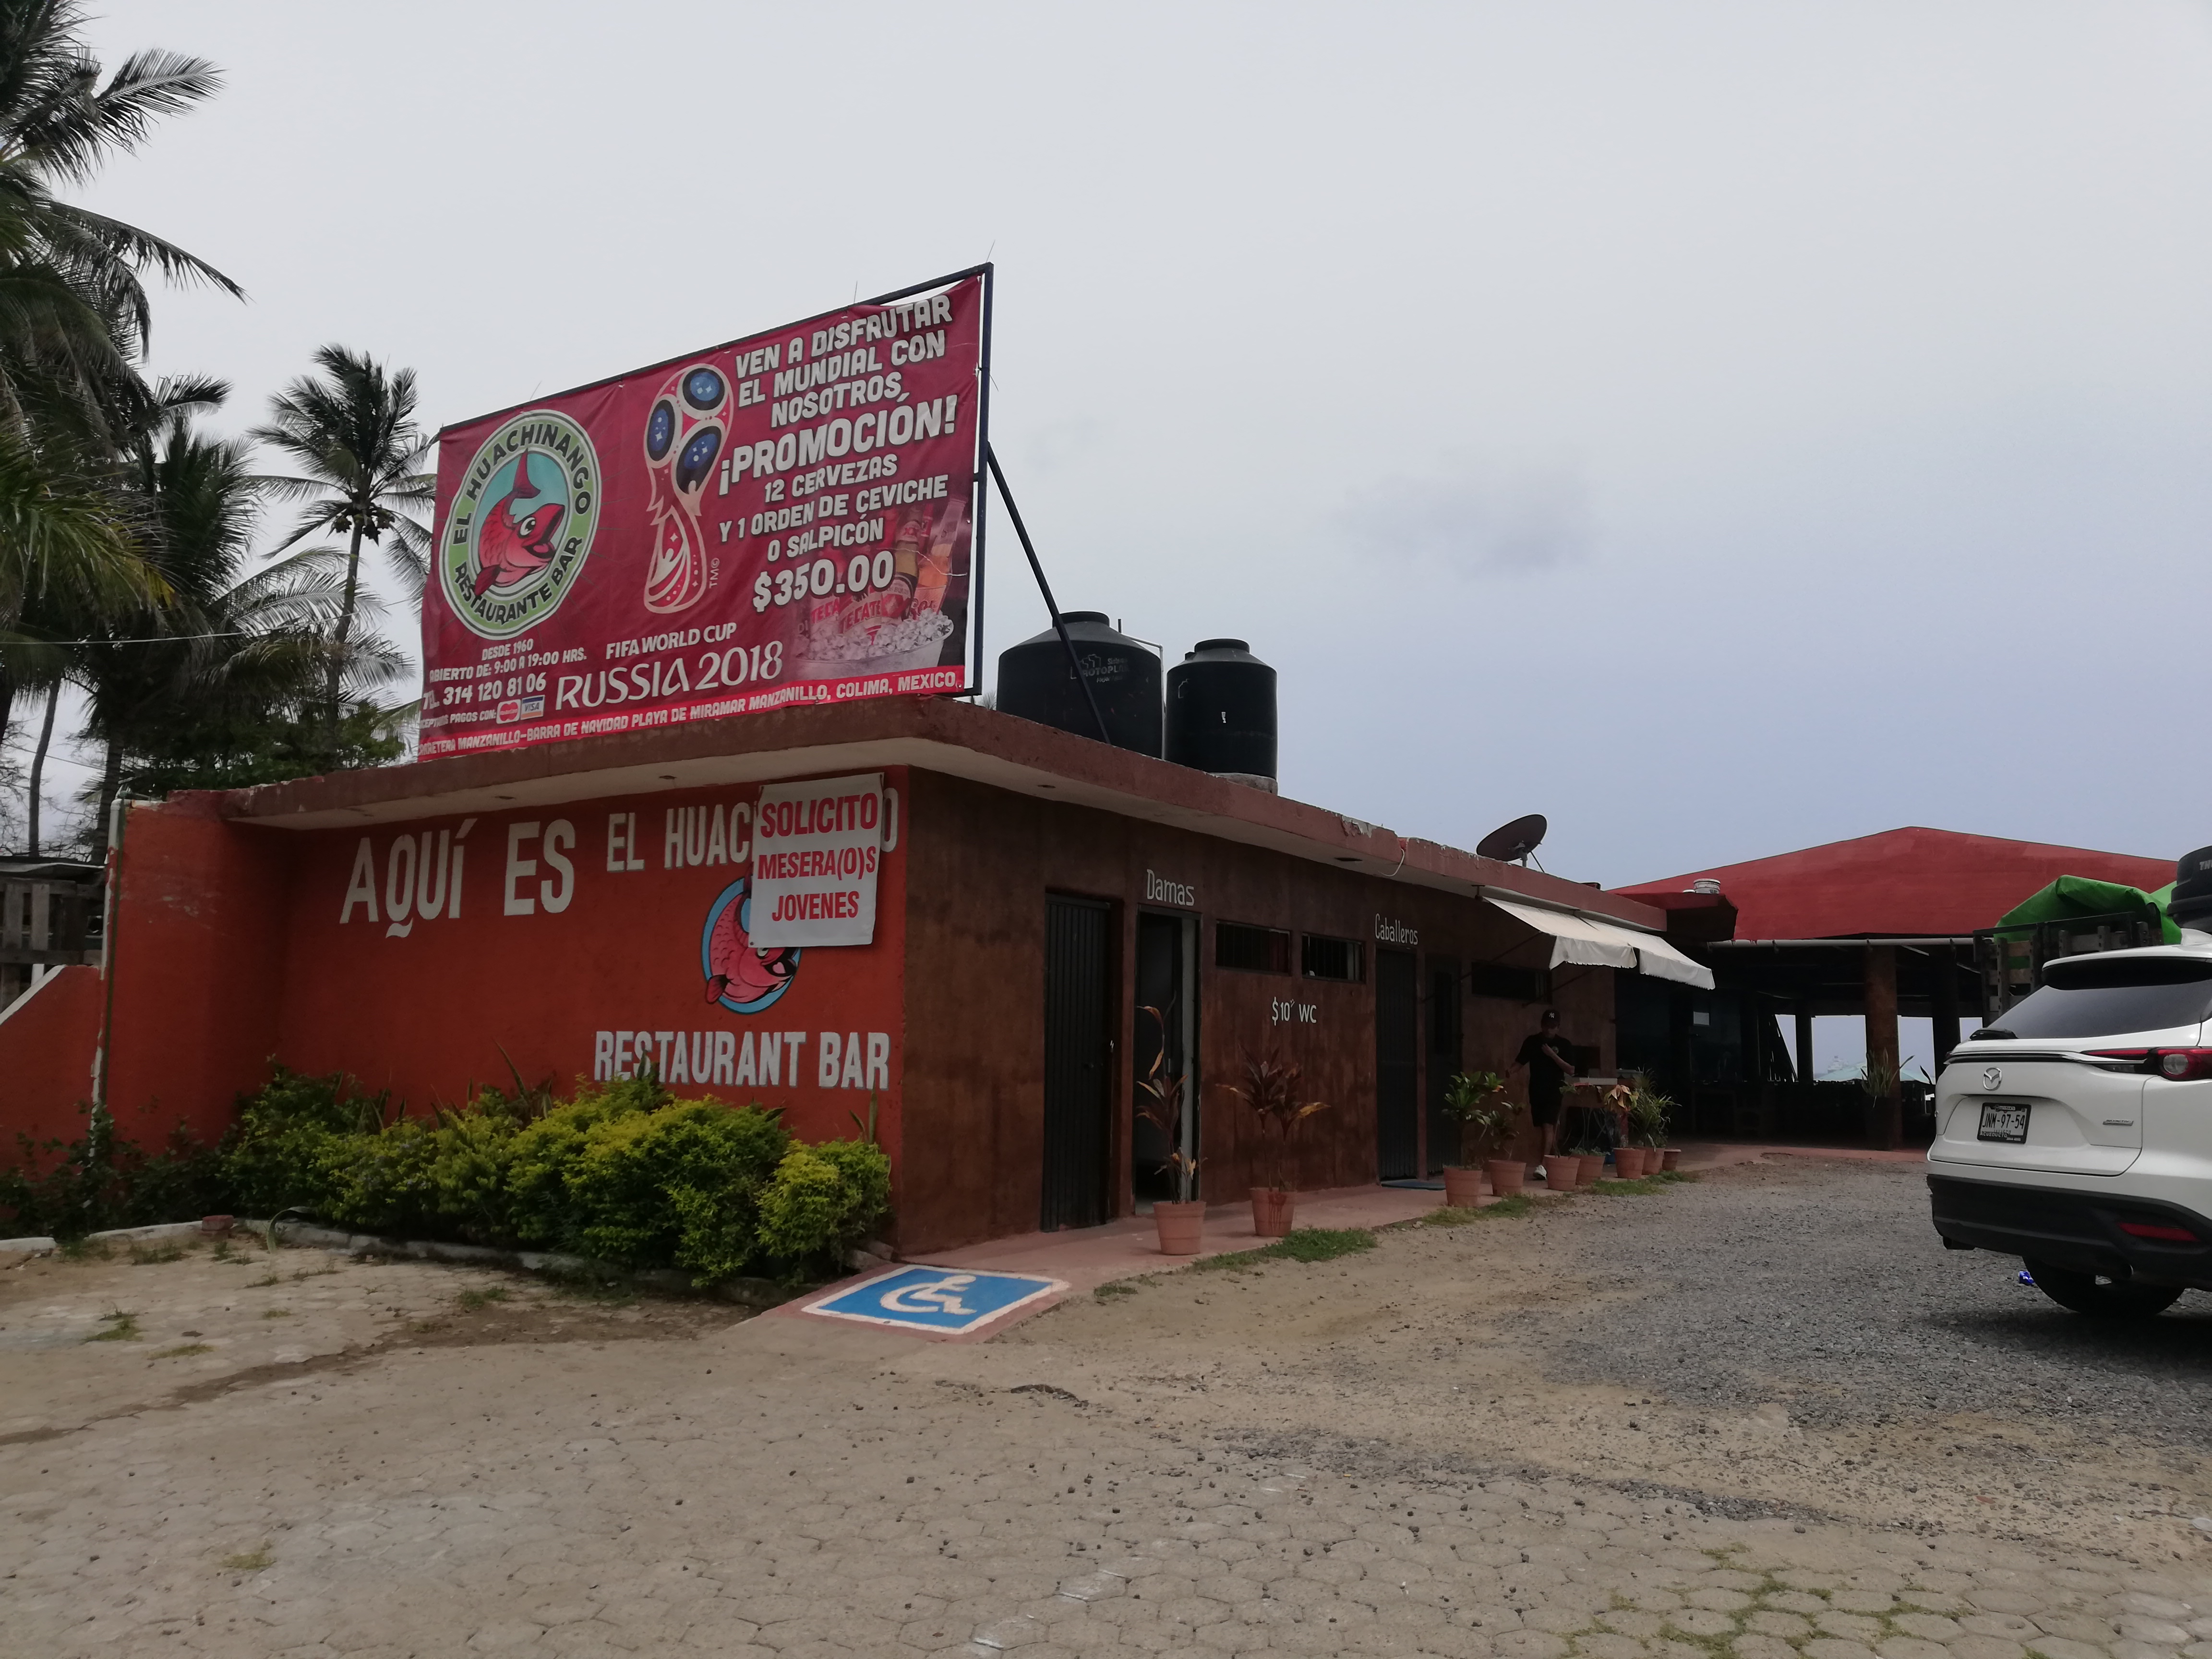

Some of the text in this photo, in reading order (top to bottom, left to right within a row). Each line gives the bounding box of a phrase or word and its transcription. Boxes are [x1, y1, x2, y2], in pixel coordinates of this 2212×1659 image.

[736, 295, 952, 379] VEN A DISFRUTAR
[739, 329, 946, 408] EL MUNDIAL CON
[453, 423, 591, 545] EL HUACHINANGO
[765, 454, 898, 503] 12 CERVEZAS
[719, 475, 949, 542] Y 1 ORDEN DE CEVICHE
[767, 514, 884, 562] O SALPICÓN
[455, 536, 582, 625] RESTAURANTE BAR
[752, 550, 895, 613] $350.00
[482, 638, 534, 661] DESDE 1960
[606, 622, 737, 660] FIFA WORLD CUP
[430, 647, 587, 683] ABIERTO DE: 9:00 A 19:00 HRS.
[443, 685, 473, 705] 314
[478, 680, 502, 701] 120
[507, 676, 523, 697] 81
[526, 672, 547, 693] 06
[555, 640, 783, 710] RUSSIA 2018
[450, 711, 478, 723] PAGOS
[479, 709, 496, 721] CON:
[525, 702, 540, 712] VISA
[564, 722, 579, 736] DE
[581, 715, 629, 734] NAVIDAD
[631, 709, 668, 731] PLAYA
[672, 707, 687, 722] DE
[690, 698, 745, 720] MIRAMAR
[836, 678, 893, 700] COLIMA,
[760, 792, 878, 839] SOLICITO
[607, 812, 645, 873] EL
[757, 845, 877, 880] MESERA(O)S
[504, 819, 576, 916] ES
[1146, 868, 1195, 907] Damas
[771, 890, 860, 922] JOVENES
[1375, 913, 1418, 945] Caballeros
[1298, 1003, 1317, 1023] WC
[594, 1031, 890, 1091] RESTAURANT BAR
[1982, 1113, 2025, 1130] JNM-97-54
